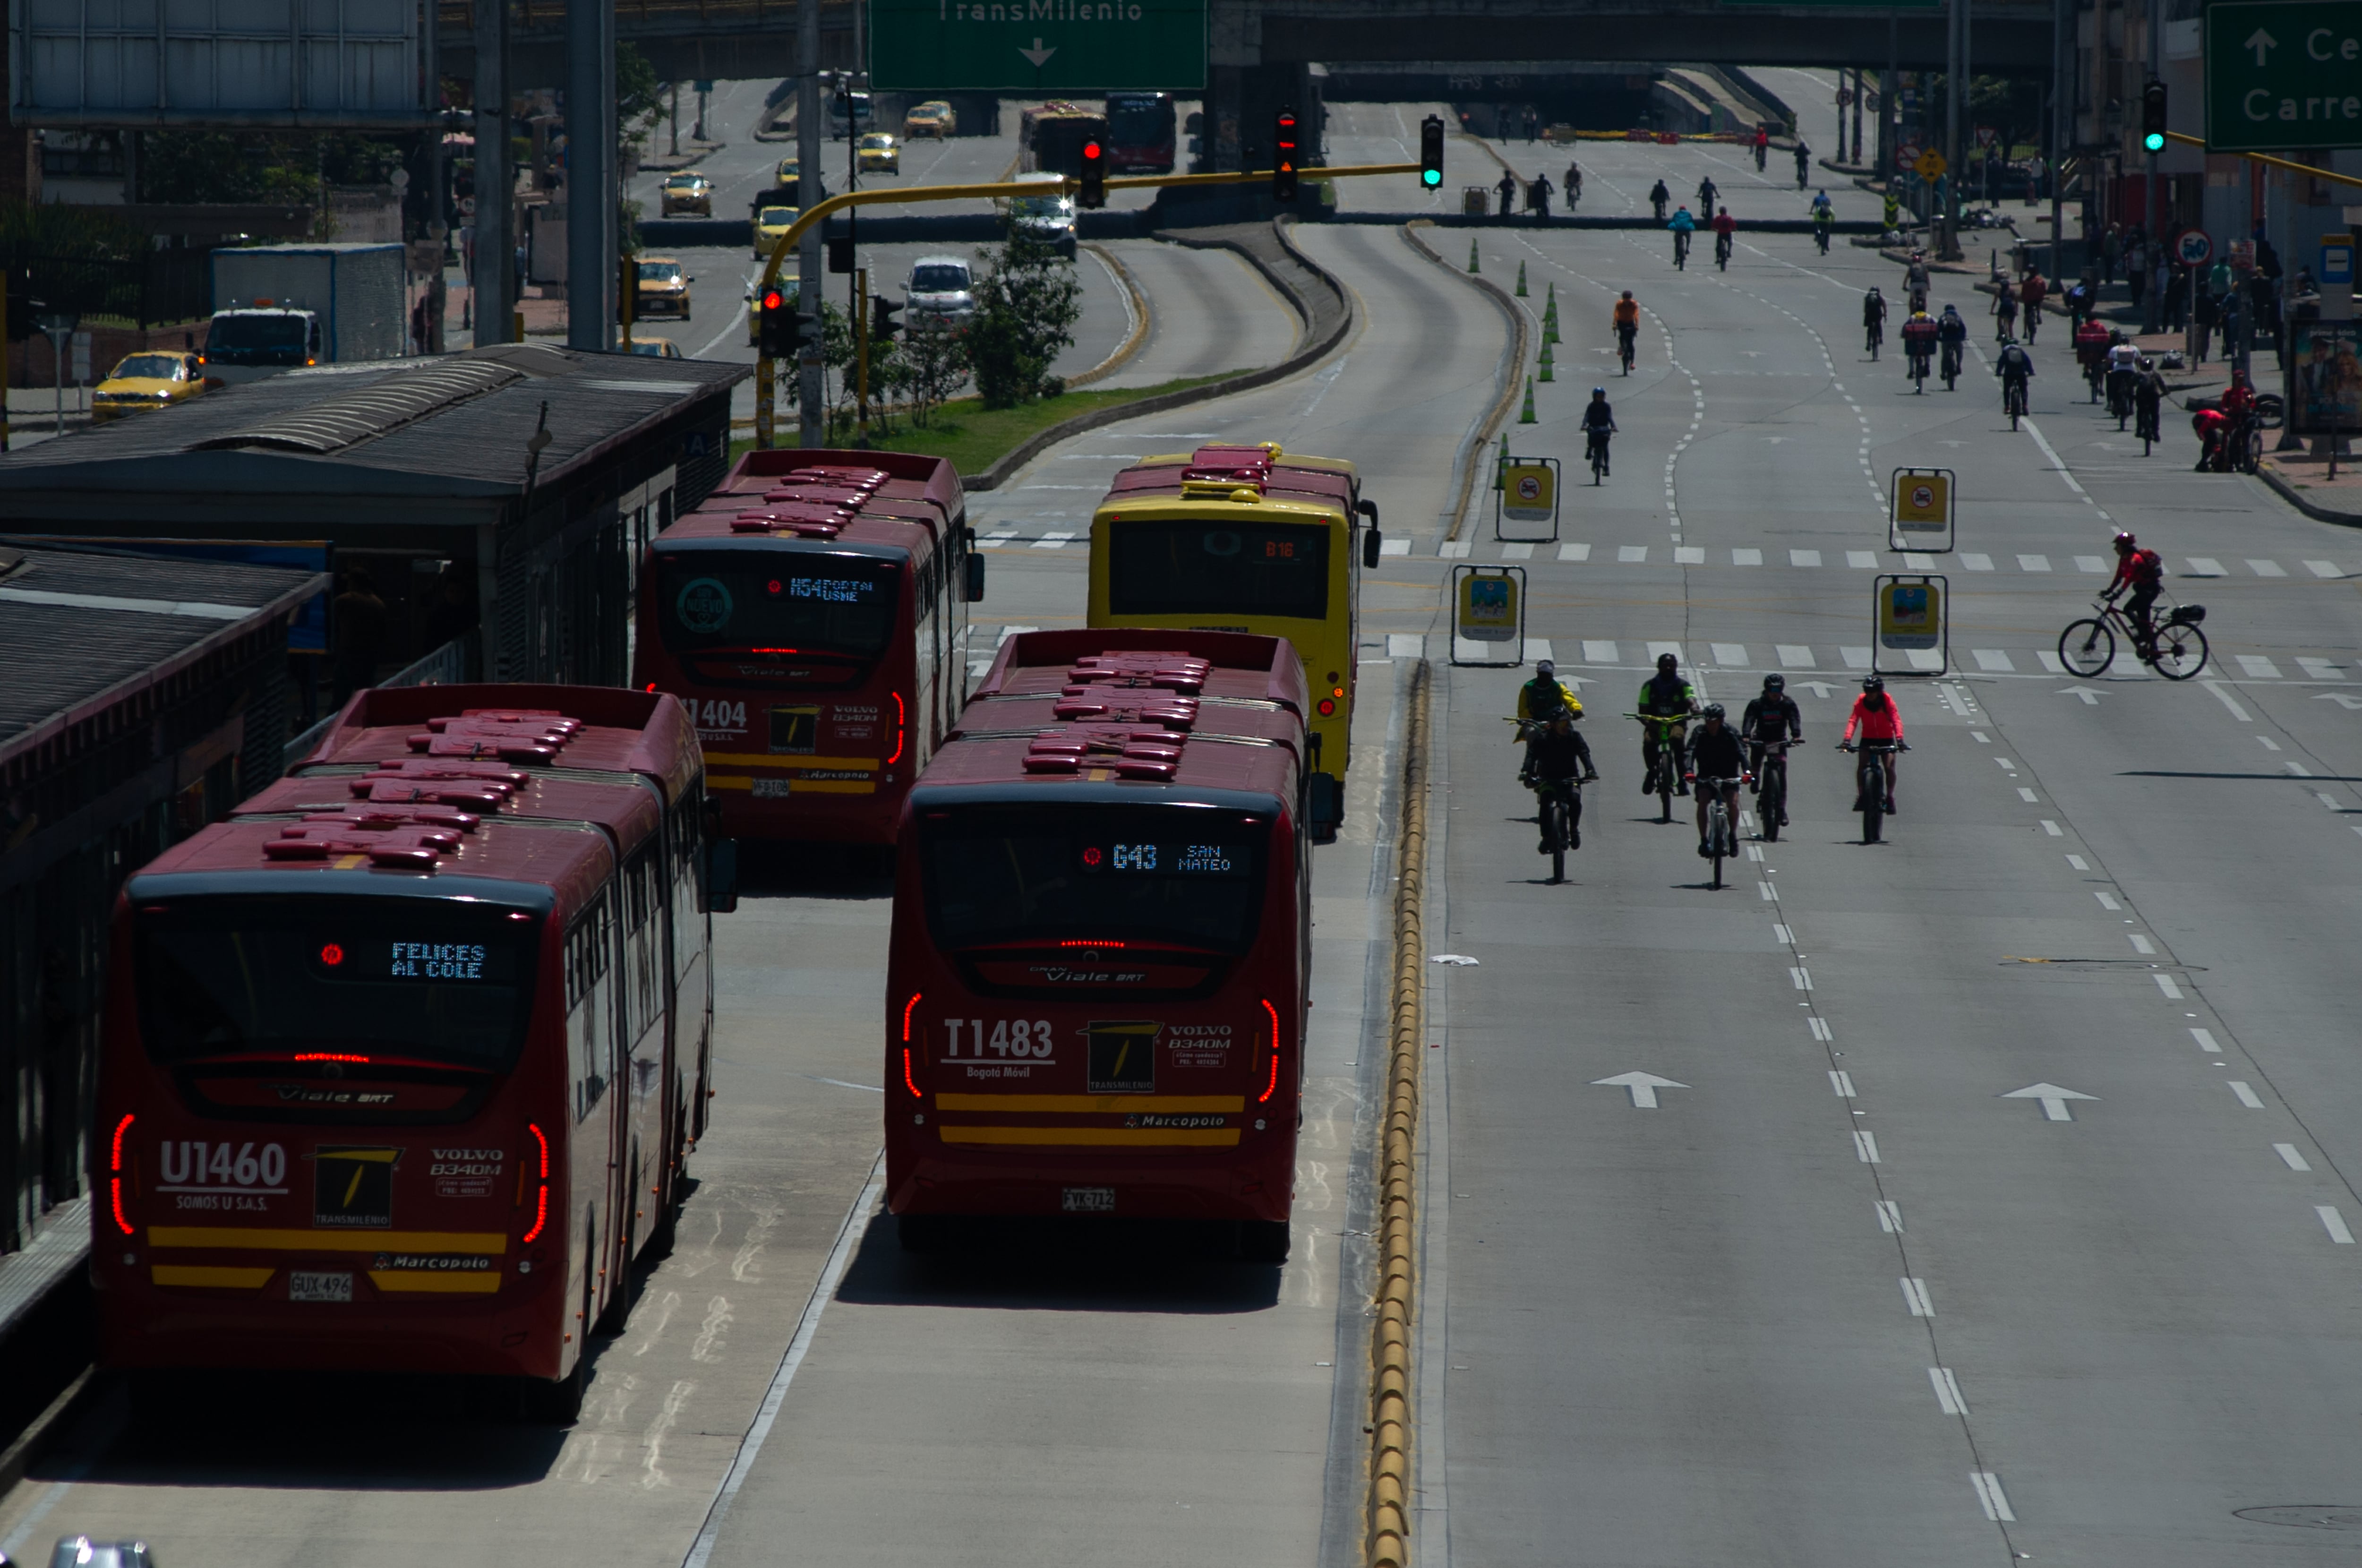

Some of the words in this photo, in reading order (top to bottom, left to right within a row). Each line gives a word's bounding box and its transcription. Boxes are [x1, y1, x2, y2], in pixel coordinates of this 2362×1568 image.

[2307, 27, 2361, 61] Ce
[2244, 88, 2362, 121] Carre
[690, 435, 705, 454] A
[1266, 540, 1294, 557] B16
[823, 590, 858, 601] USME
[682, 698, 746, 728] 1404
[834, 705, 878, 713] VOLVO
[810, 771, 869, 779] Marcopolo
[1113, 844, 1157, 869] G43
[1187, 845, 1220, 857] SAN
[1178, 858, 1230, 871] MATEO
[393, 943, 486, 961] FELICES
[392, 960, 420, 976] AL
[426, 961, 483, 978] COLE
[1046, 972, 1109, 981] Viale
[1115, 974, 1145, 982] BRT
[1169, 1025, 1232, 1036] VOLVO
[945, 1019, 1053, 1058] T1483
[1168, 1039, 1231, 1049] B340M
[967, 1066, 1001, 1080] Bogotá
[1003, 1067, 1030, 1078] Móvil
[277, 1088, 350, 1102] Viale
[357, 1094, 394, 1103] BRT
[1142, 1116, 1224, 1127] Marcopolo
[431, 1149, 504, 1161] VOLVO
[161, 1140, 286, 1186] U1460
[430, 1164, 502, 1175] B340M
[176, 1195, 218, 1209] SOMOS
[222, 1196, 232, 1210] U
[236, 1196, 266, 1211] S.A.S.
[316, 1215, 388, 1225] TRANSMILENIO
[393, 1256, 489, 1269] Marcopolo
